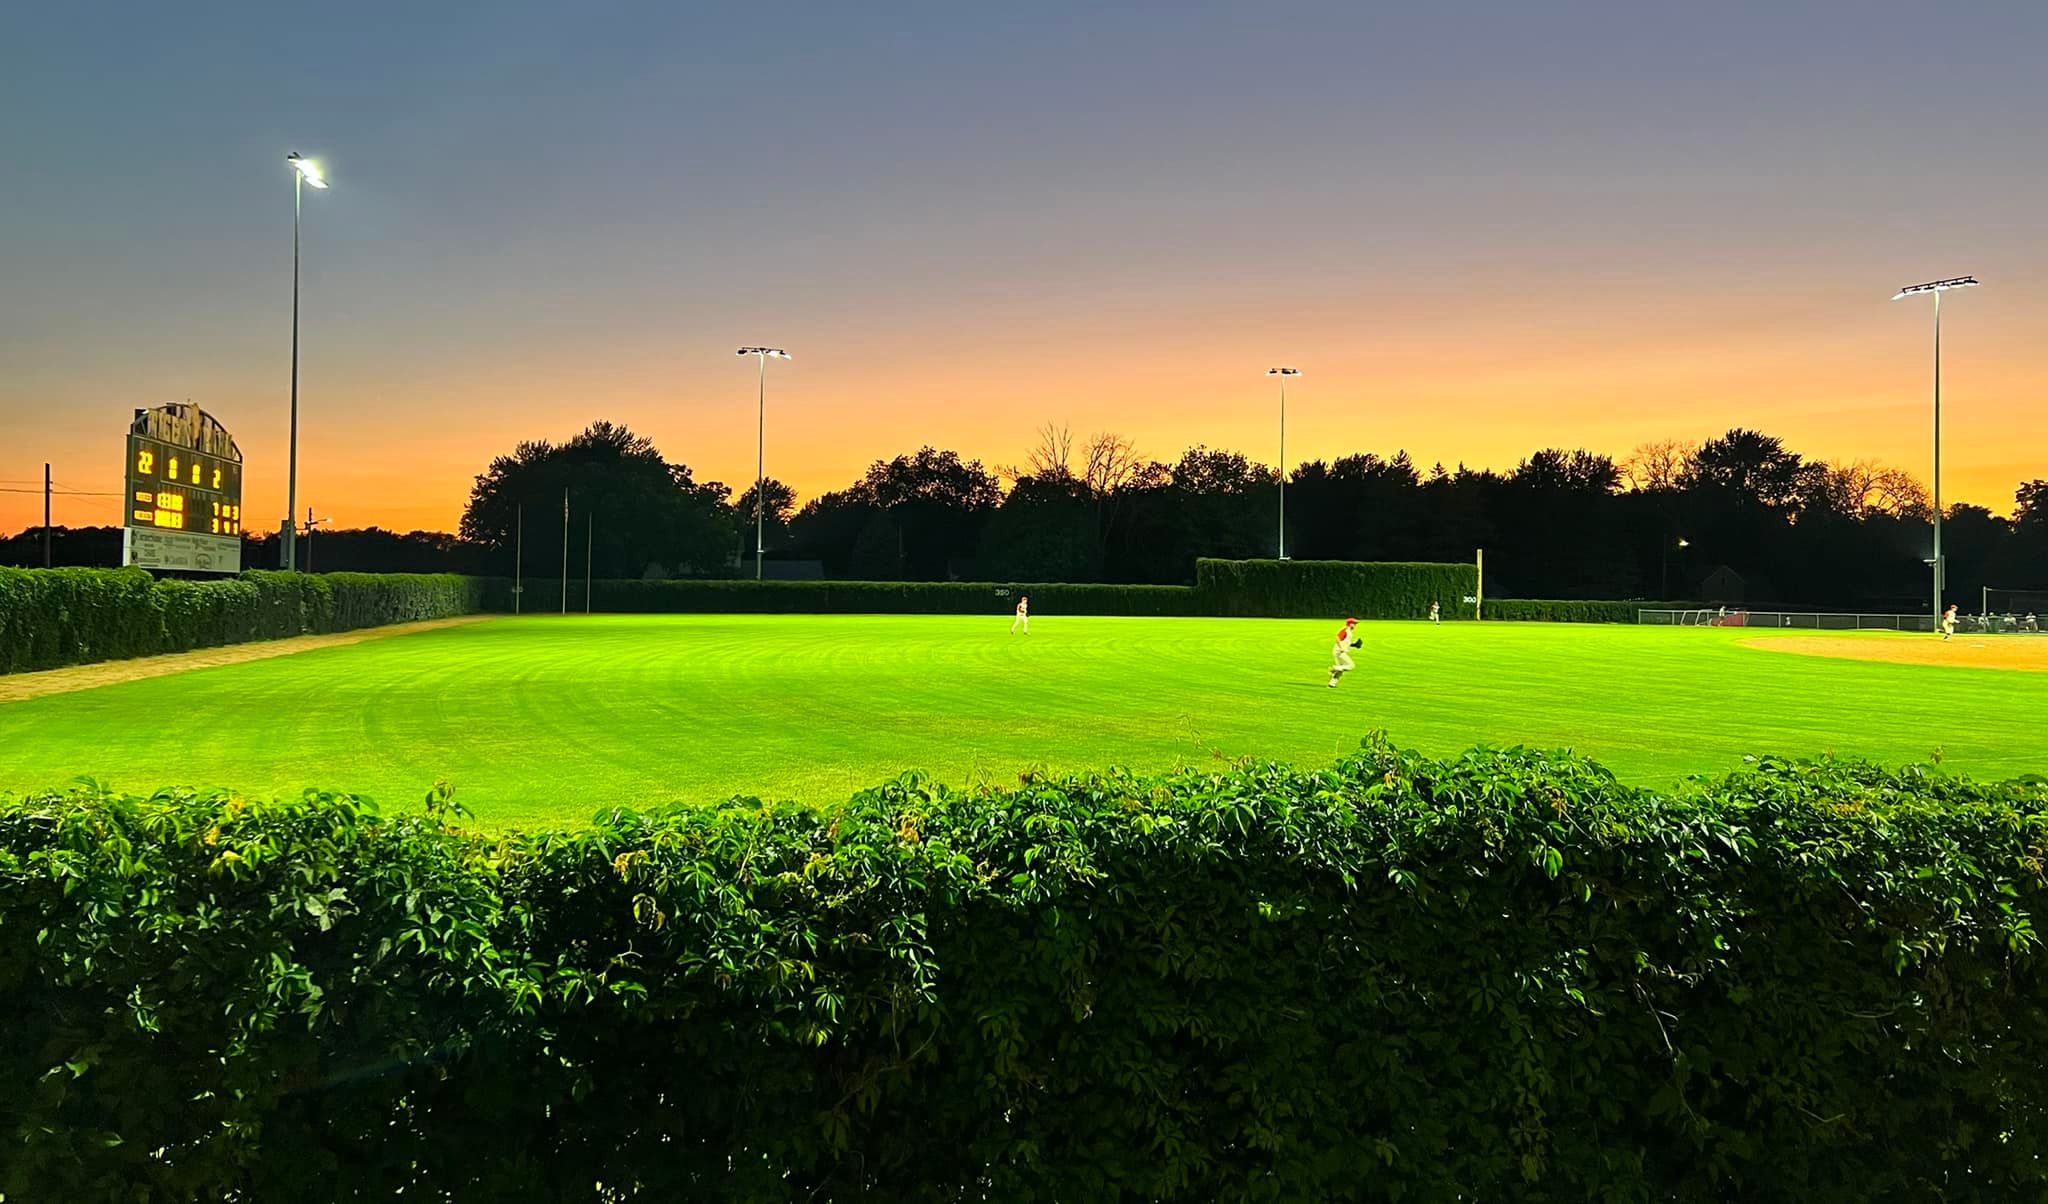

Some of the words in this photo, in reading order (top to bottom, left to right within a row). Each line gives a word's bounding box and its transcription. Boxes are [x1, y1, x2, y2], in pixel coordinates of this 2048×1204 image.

[138, 451, 153, 474] 22
[212, 469, 221, 488] 2
[212, 502, 219, 516] 1
